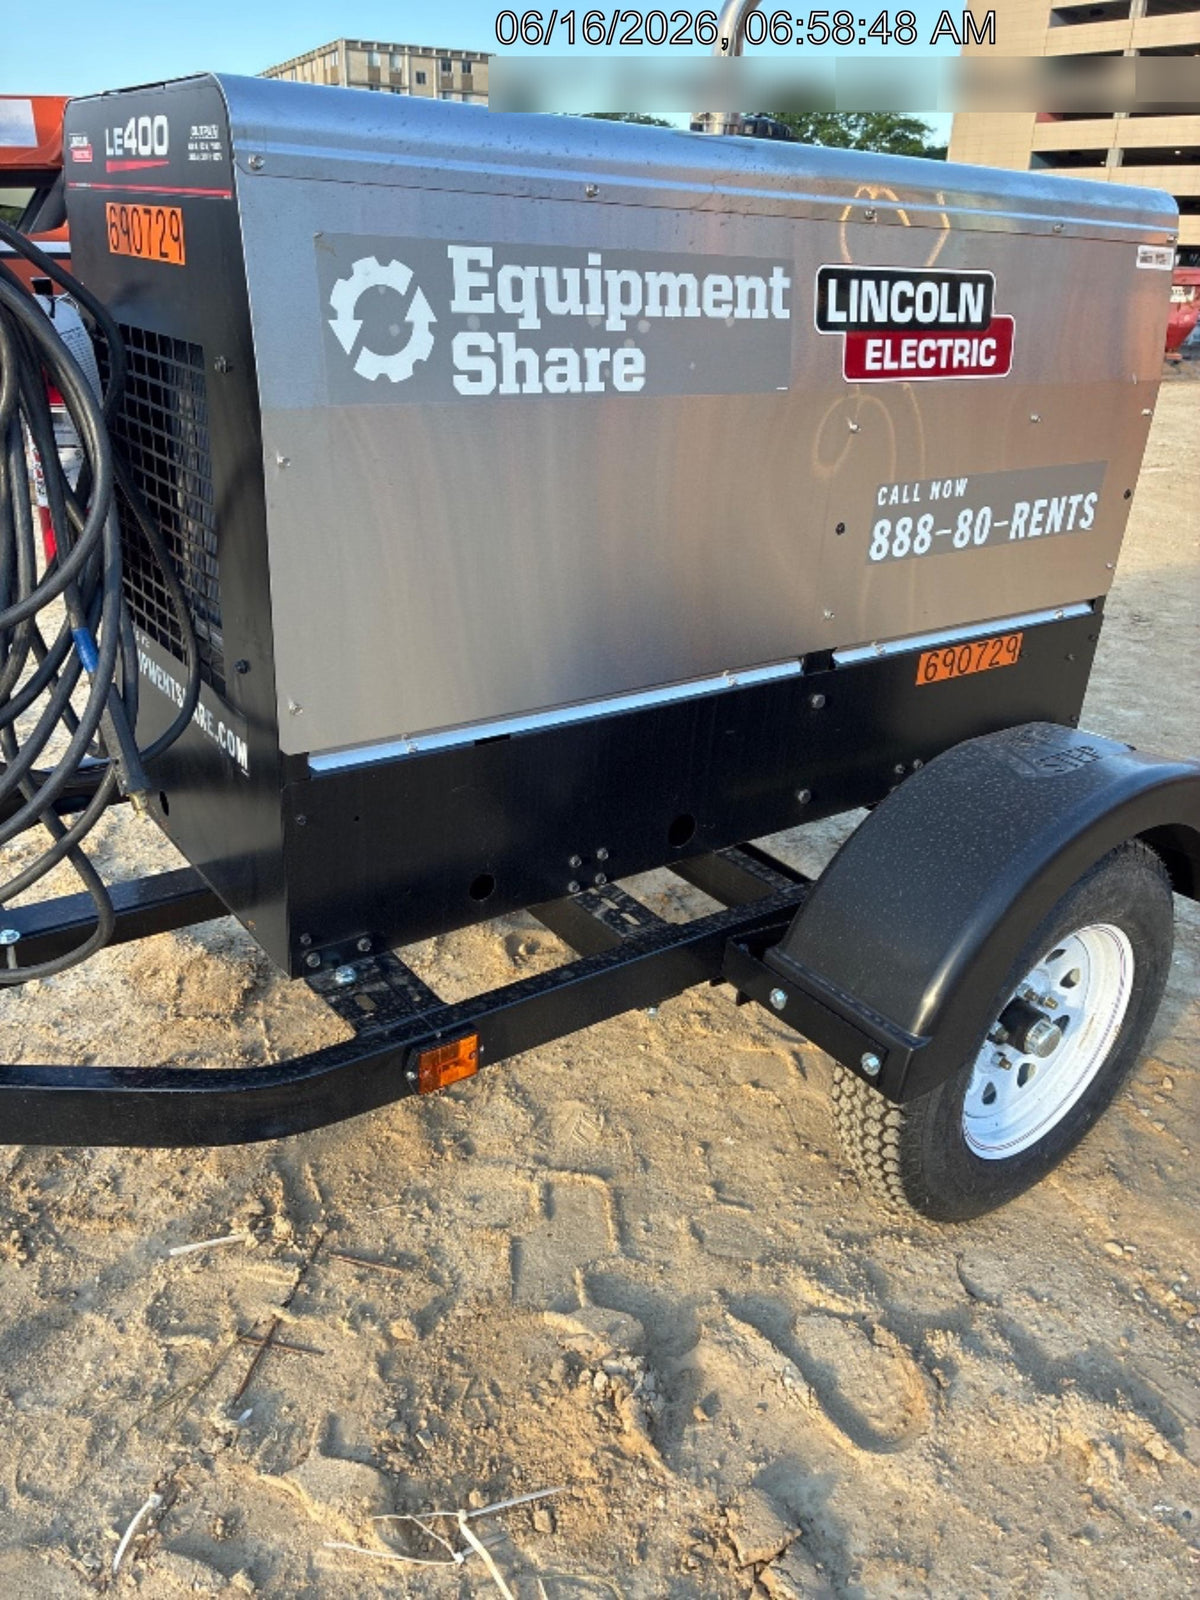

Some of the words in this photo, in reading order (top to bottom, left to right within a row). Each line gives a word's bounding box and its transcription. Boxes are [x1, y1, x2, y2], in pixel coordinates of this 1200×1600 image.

[105, 115, 169, 156] LE400
[109, 206, 183, 261] 690729
[447, 245, 791, 331] Equipment
[827, 279, 985, 324] LINCOLN
[452, 332, 646, 395] Share
[865, 338, 997, 371] ELECTRIC
[877, 483, 921, 506] CALL
[929, 478, 968, 500] NOW
[869, 491, 1098, 561] 888-80-RENTS
[924, 636, 1018, 681] 690729
